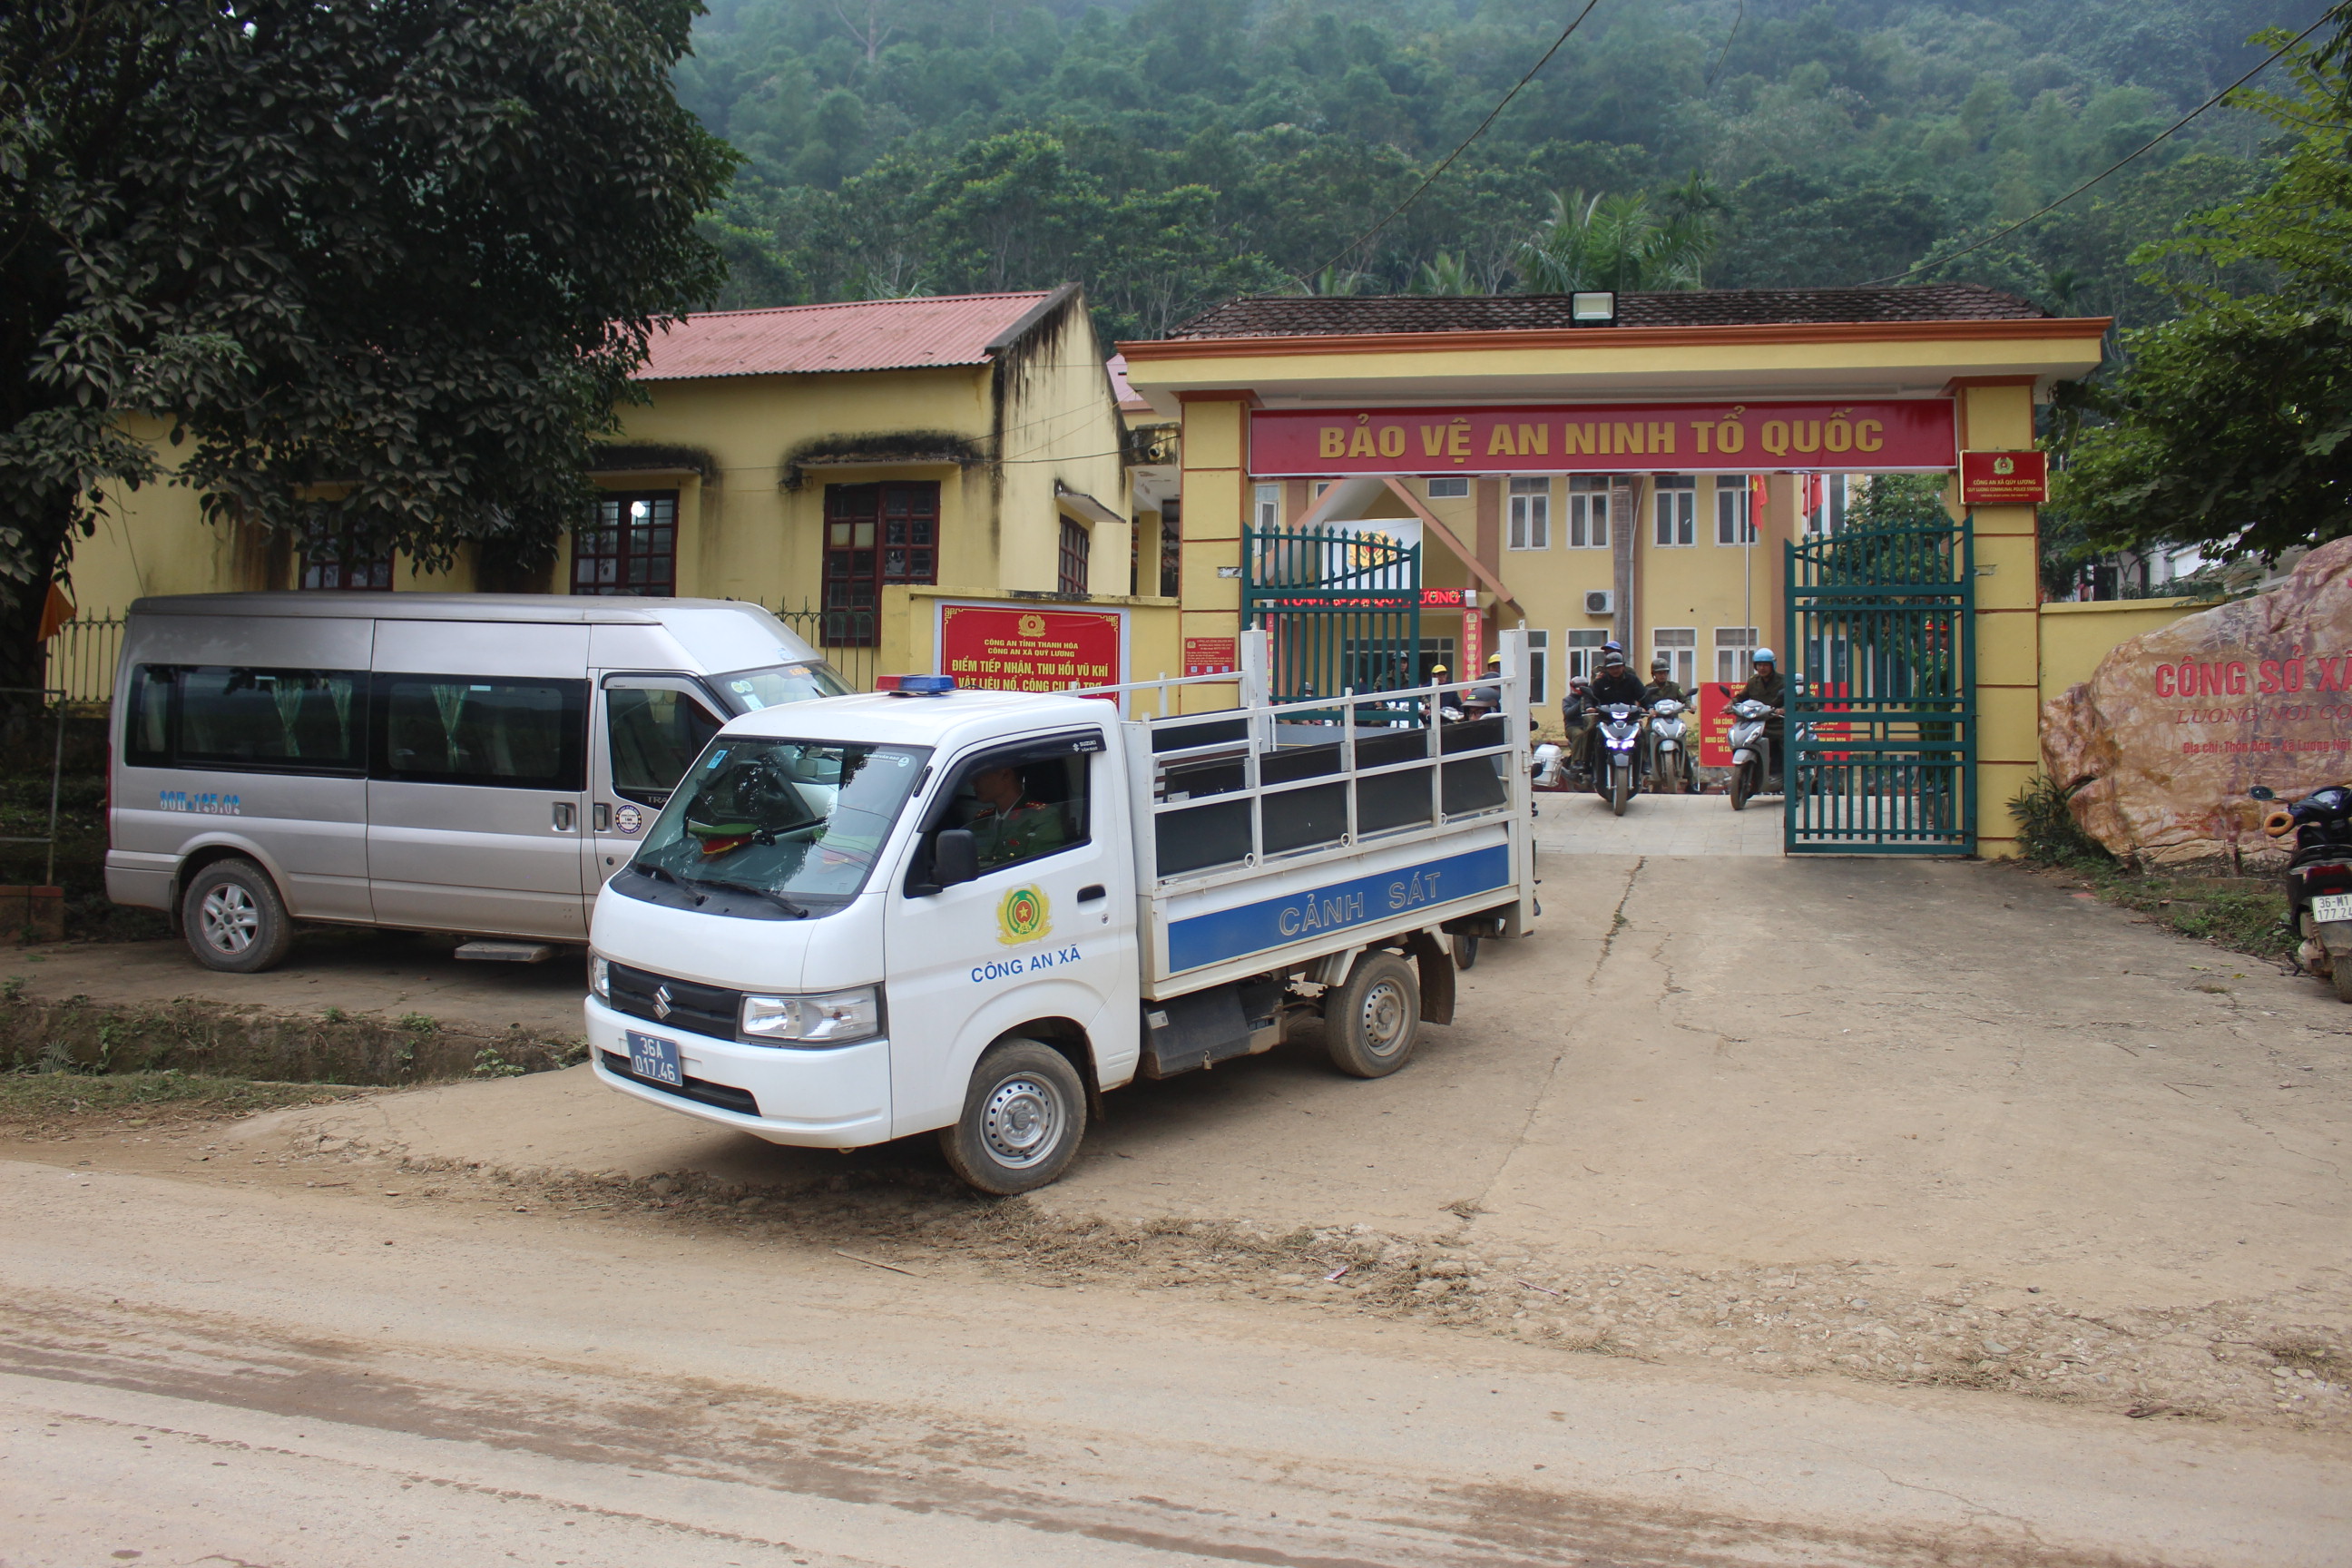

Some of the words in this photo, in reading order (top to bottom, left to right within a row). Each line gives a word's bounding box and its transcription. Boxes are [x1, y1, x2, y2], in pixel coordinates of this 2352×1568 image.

[1319, 413, 1406, 458] BẢO
[1420, 416, 1472, 464] VỆ
[1487, 423, 1549, 456] AN
[1565, 421, 1675, 455] NINH
[1690, 406, 1747, 454] TỔ
[1761, 407, 1883, 456] QUỐC
[985, 638, 1004, 646] CÔNG
[1019, 639, 1036, 648] TỈNH
[1038, 641, 1062, 649] THANH
[1063, 642, 1079, 650] HÓA
[988, 647, 1008, 655] CÔNG
[1023, 648, 1033, 656] XÃ
[1051, 650, 1075, 658] LƯƠNG
[952, 655, 977, 671] ĐIỂM
[980, 657, 1001, 673] TIẾP
[1004, 661, 1034, 676] NHẬN,
[1037, 662, 1055, 675] THU
[1058, 661, 1074, 676] HỒI
[1077, 662, 1089, 677] VŨ
[1092, 662, 1108, 677] KHÍ
[2156, 656, 2247, 698] CÔNG
[2259, 644, 2307, 694] SỞ
[1023, 678, 1049, 692] CÔNG
[2175, 708, 2259, 724] LUONG
[2265, 706, 2314, 721] NOI
[1279, 892, 1364, 936] CẢNH
[1389, 871, 1441, 909] SÁT
[971, 959, 1024, 983] CÔNG
[1030, 953, 1054, 971] AN
[1058, 944, 1082, 965] XÃ
[641, 1037, 663, 1059] 36A
[635, 1054, 676, 1082] 017.46
